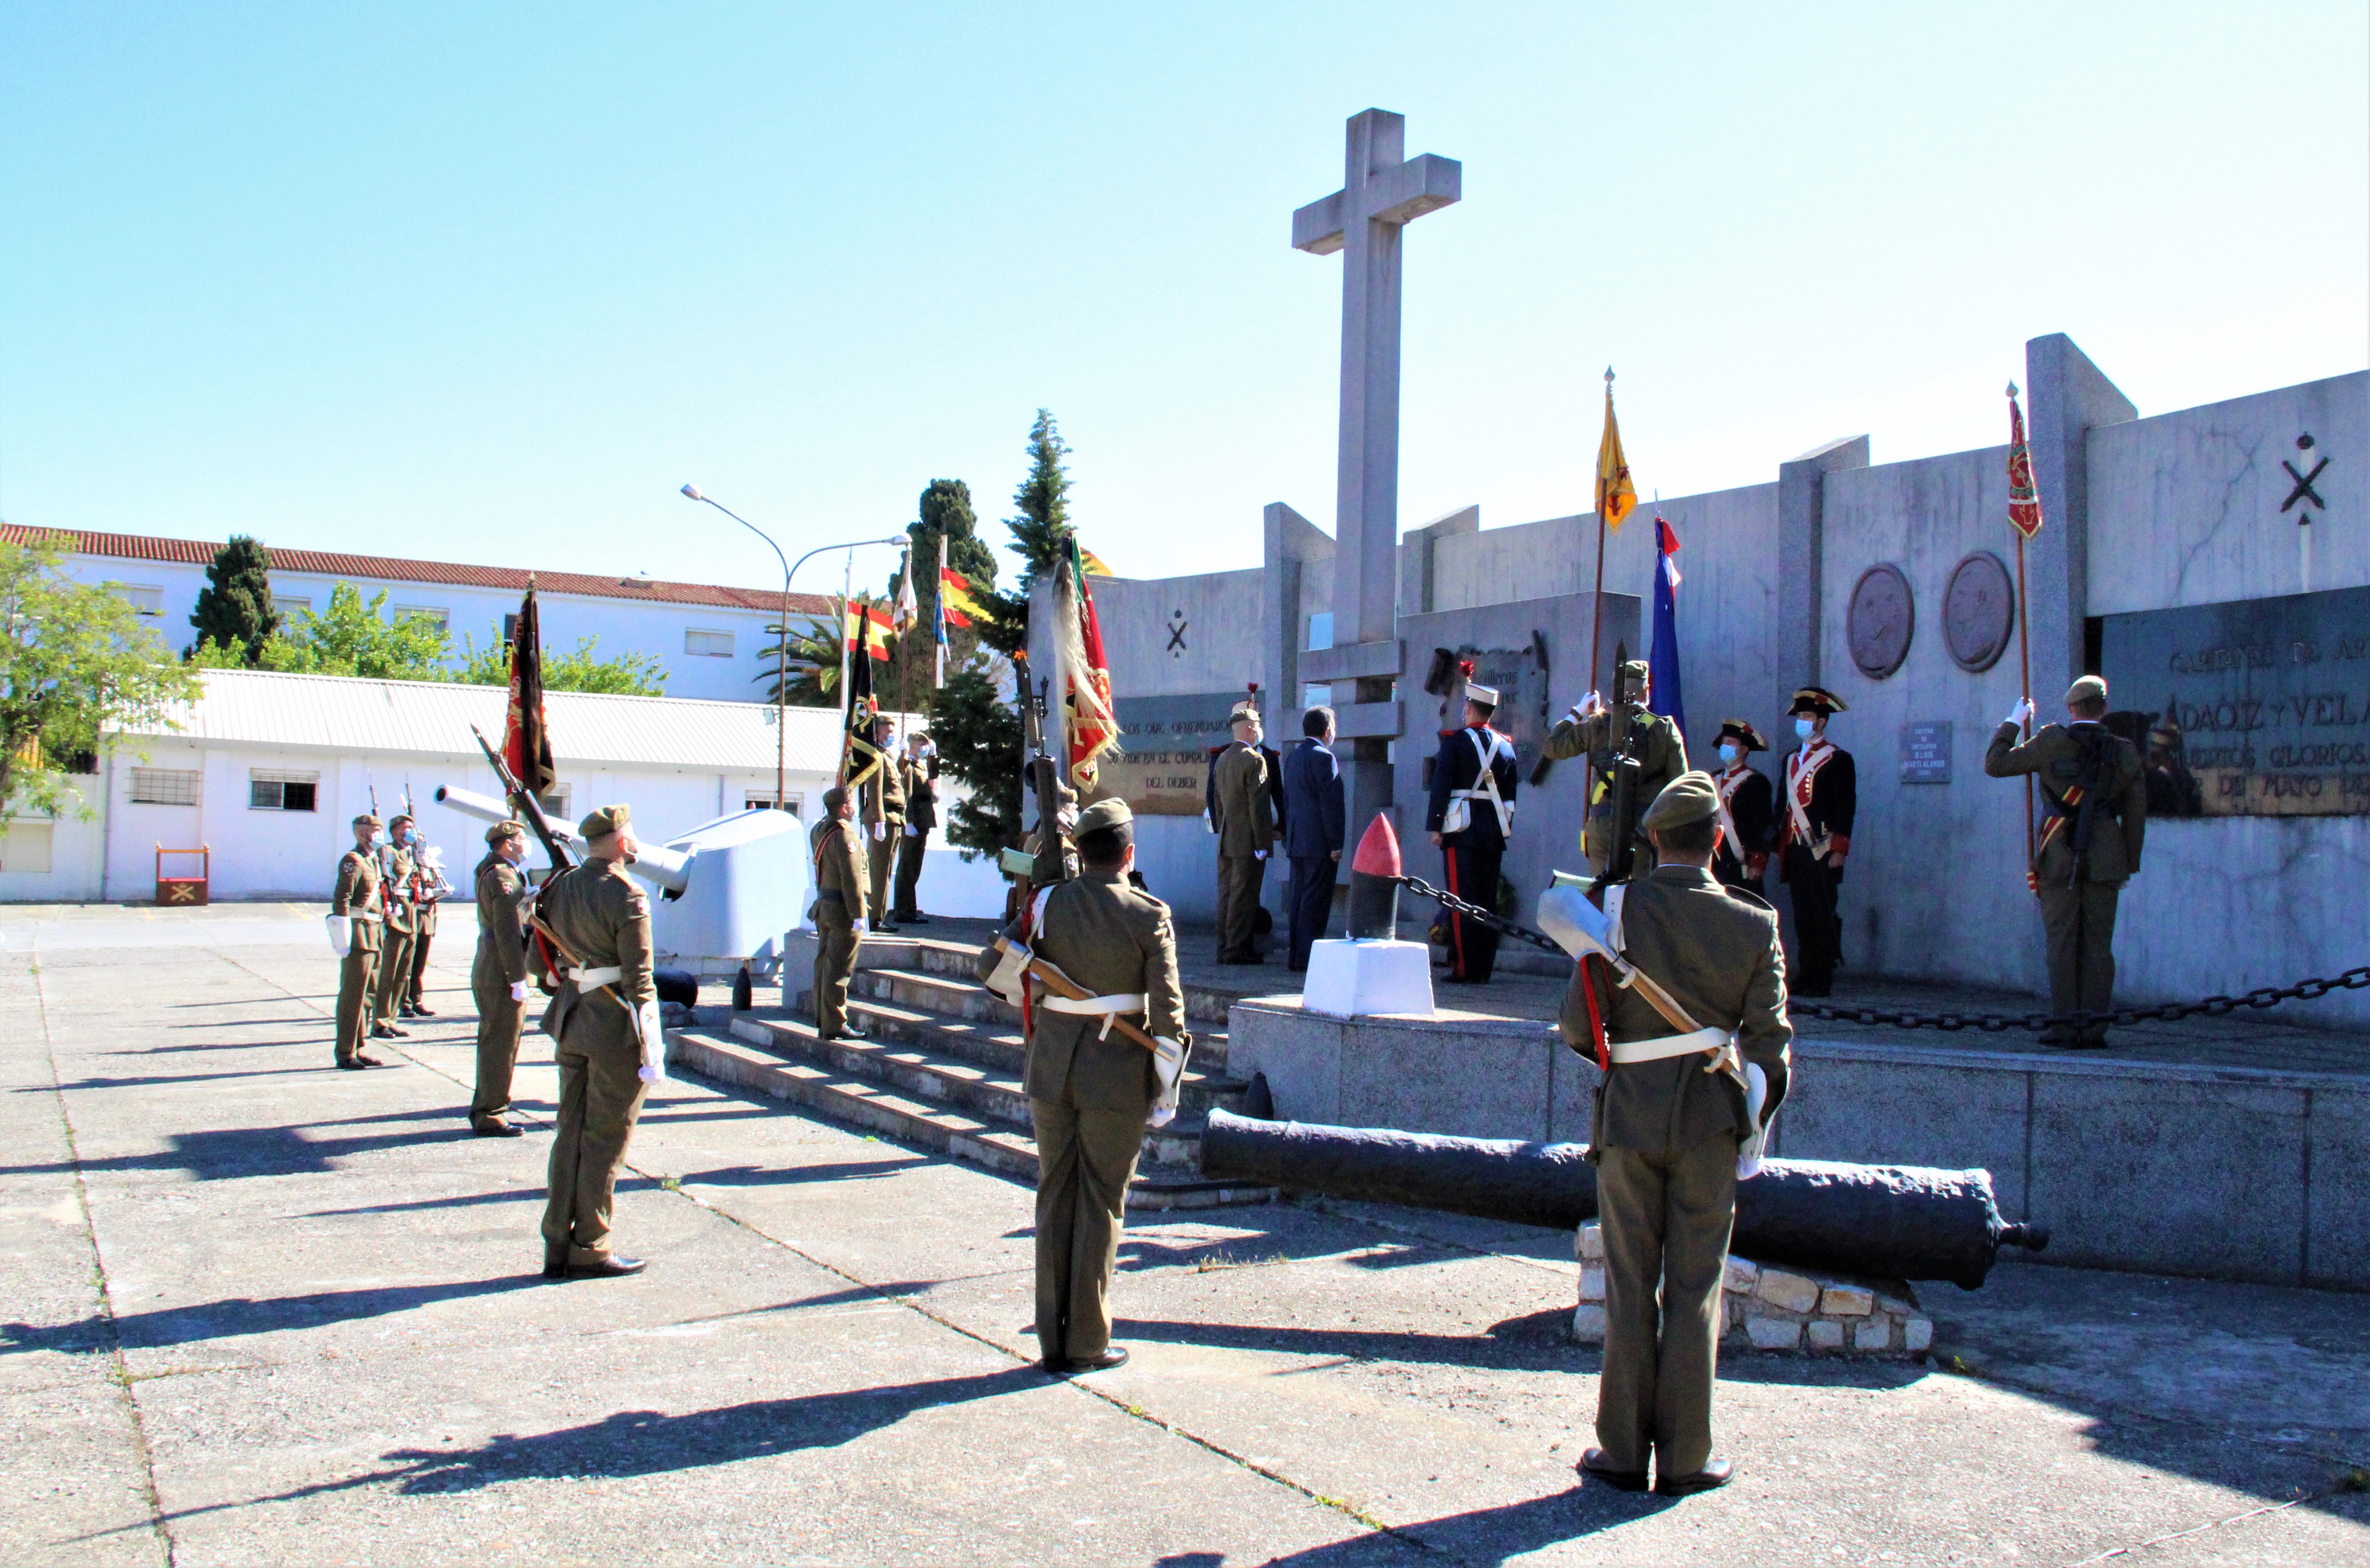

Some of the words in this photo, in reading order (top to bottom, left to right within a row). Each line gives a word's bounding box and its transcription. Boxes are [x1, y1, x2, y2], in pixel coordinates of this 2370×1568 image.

[2179, 699, 2264, 731] DAOIZ
[1123, 722, 1140, 735] LOS
[1145, 722, 1165, 734] QUE
[1171, 720, 1231, 734] OFRENDARO
[1107, 752, 1118, 764] SU
[1123, 752, 1141, 764] VIDA
[1143, 752, 1155, 764] EN
[1159, 751, 1170, 763] EL
[1175, 751, 1210, 764] CUMPLI
[2269, 742, 2368, 767] GLORIOS
[1146, 777, 1164, 788] DEL
[1167, 777, 1197, 788] DEBER
[2218, 775, 2246, 797] DE
[2264, 773, 2322, 797] MAYO
